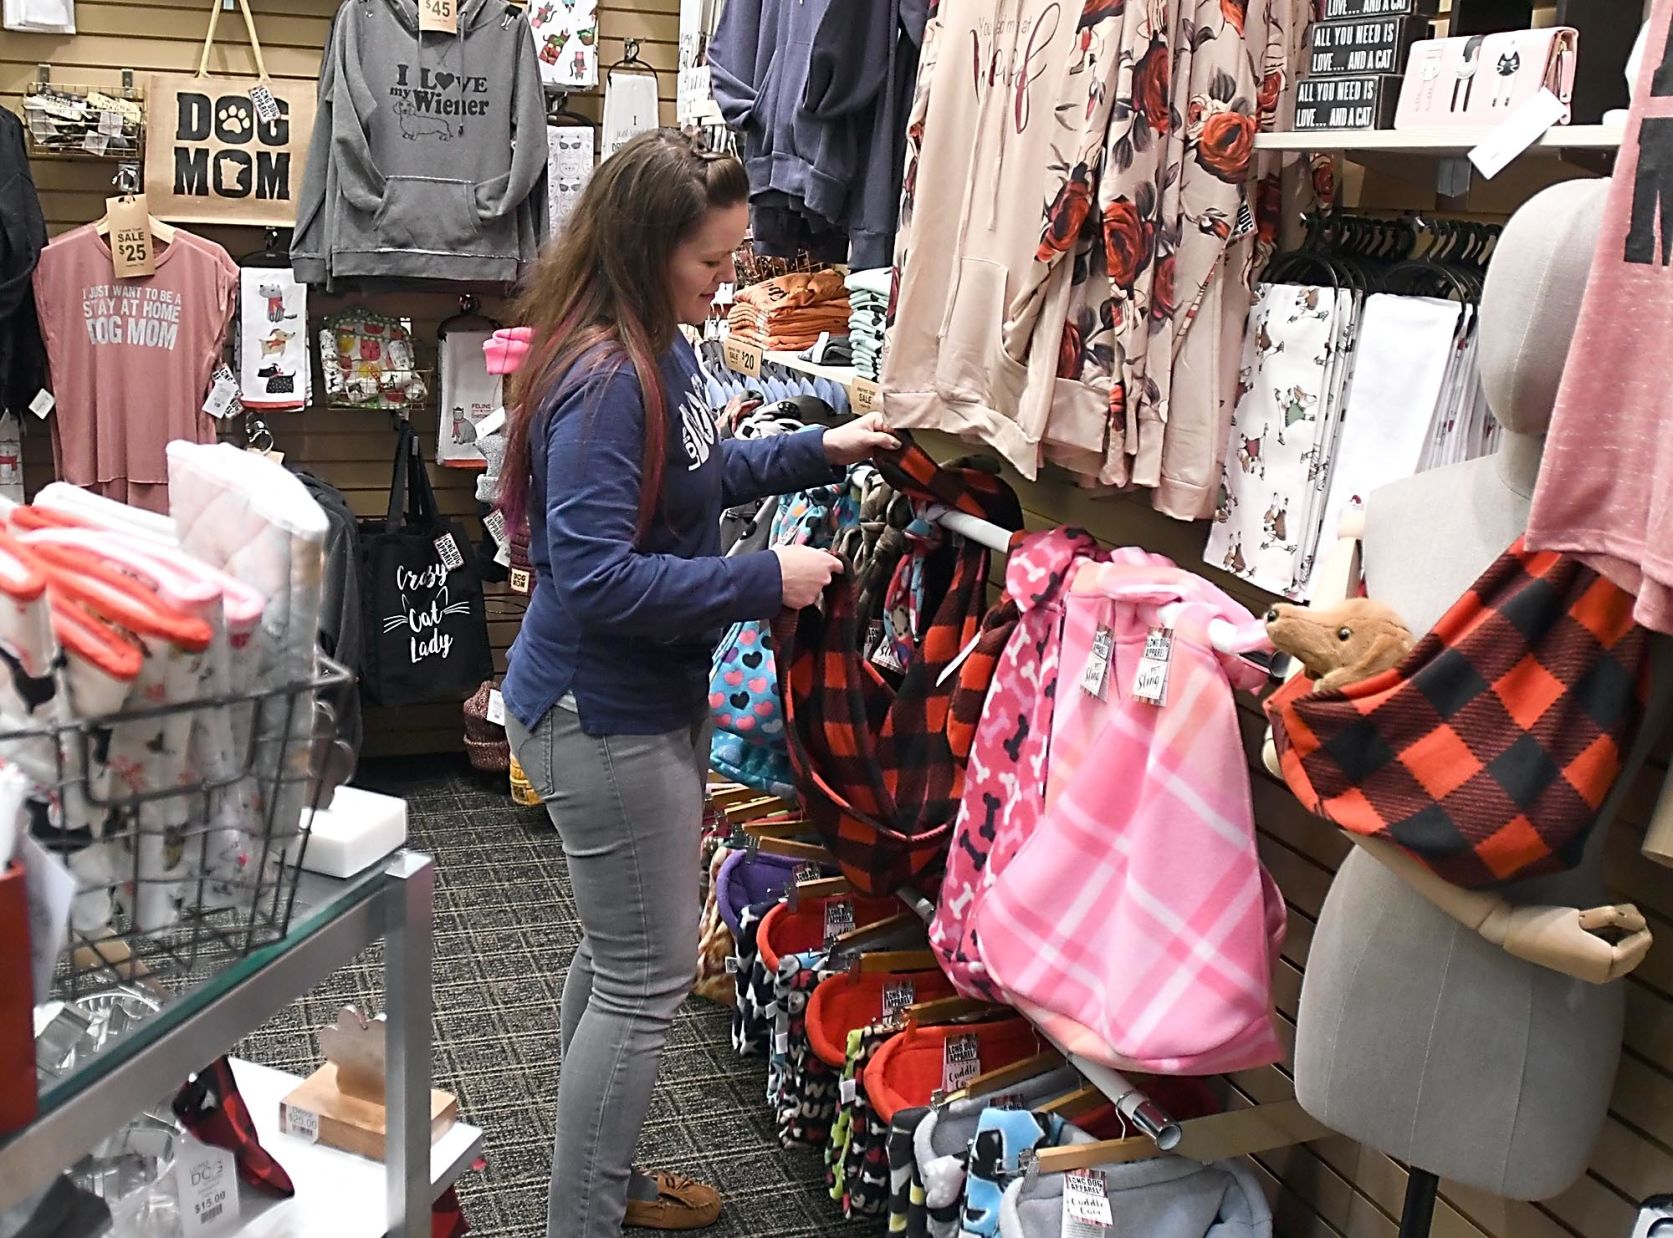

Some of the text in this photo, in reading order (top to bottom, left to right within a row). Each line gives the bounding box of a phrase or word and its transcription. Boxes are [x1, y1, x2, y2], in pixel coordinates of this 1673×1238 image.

[1314, 23, 1394, 47] ALL YOU NEED IS
[1347, 51, 1366, 70] AND
[1367, 51, 1374, 69] A
[1375, 49, 1393, 69] CAT
[396, 64, 409, 86] I
[389, 87, 489, 116] my Wiener
[1298, 81, 1374, 102] ALL YOU NEED IS
[176, 92, 289, 147] DOG
[1329, 107, 1347, 126] AND
[1347, 107, 1354, 126] A
[1355, 106, 1372, 126] CAT
[173, 146, 291, 200] MOM
[117, 232, 145, 243] SALE
[119, 244, 147, 261] $25
[83, 284, 182, 304] I JUST WANT TO BE A
[83, 299, 182, 323] STAY AT HOME
[127, 317, 180, 350] MOM
[742, 351, 755, 370] $20
[858, 392, 872, 405] SALE
[443, 536, 456, 552] LONG
[396, 563, 449, 591] Crazy
[409, 600, 443, 633] Cat
[411, 628, 453, 663] Lady
[1137, 673, 1160, 691] Sling
[1068, 1176, 1103, 1188] LONG DOG
[1070, 1183, 1101, 1194] APPAREL
[194, 1190, 226, 1214] $15.00
